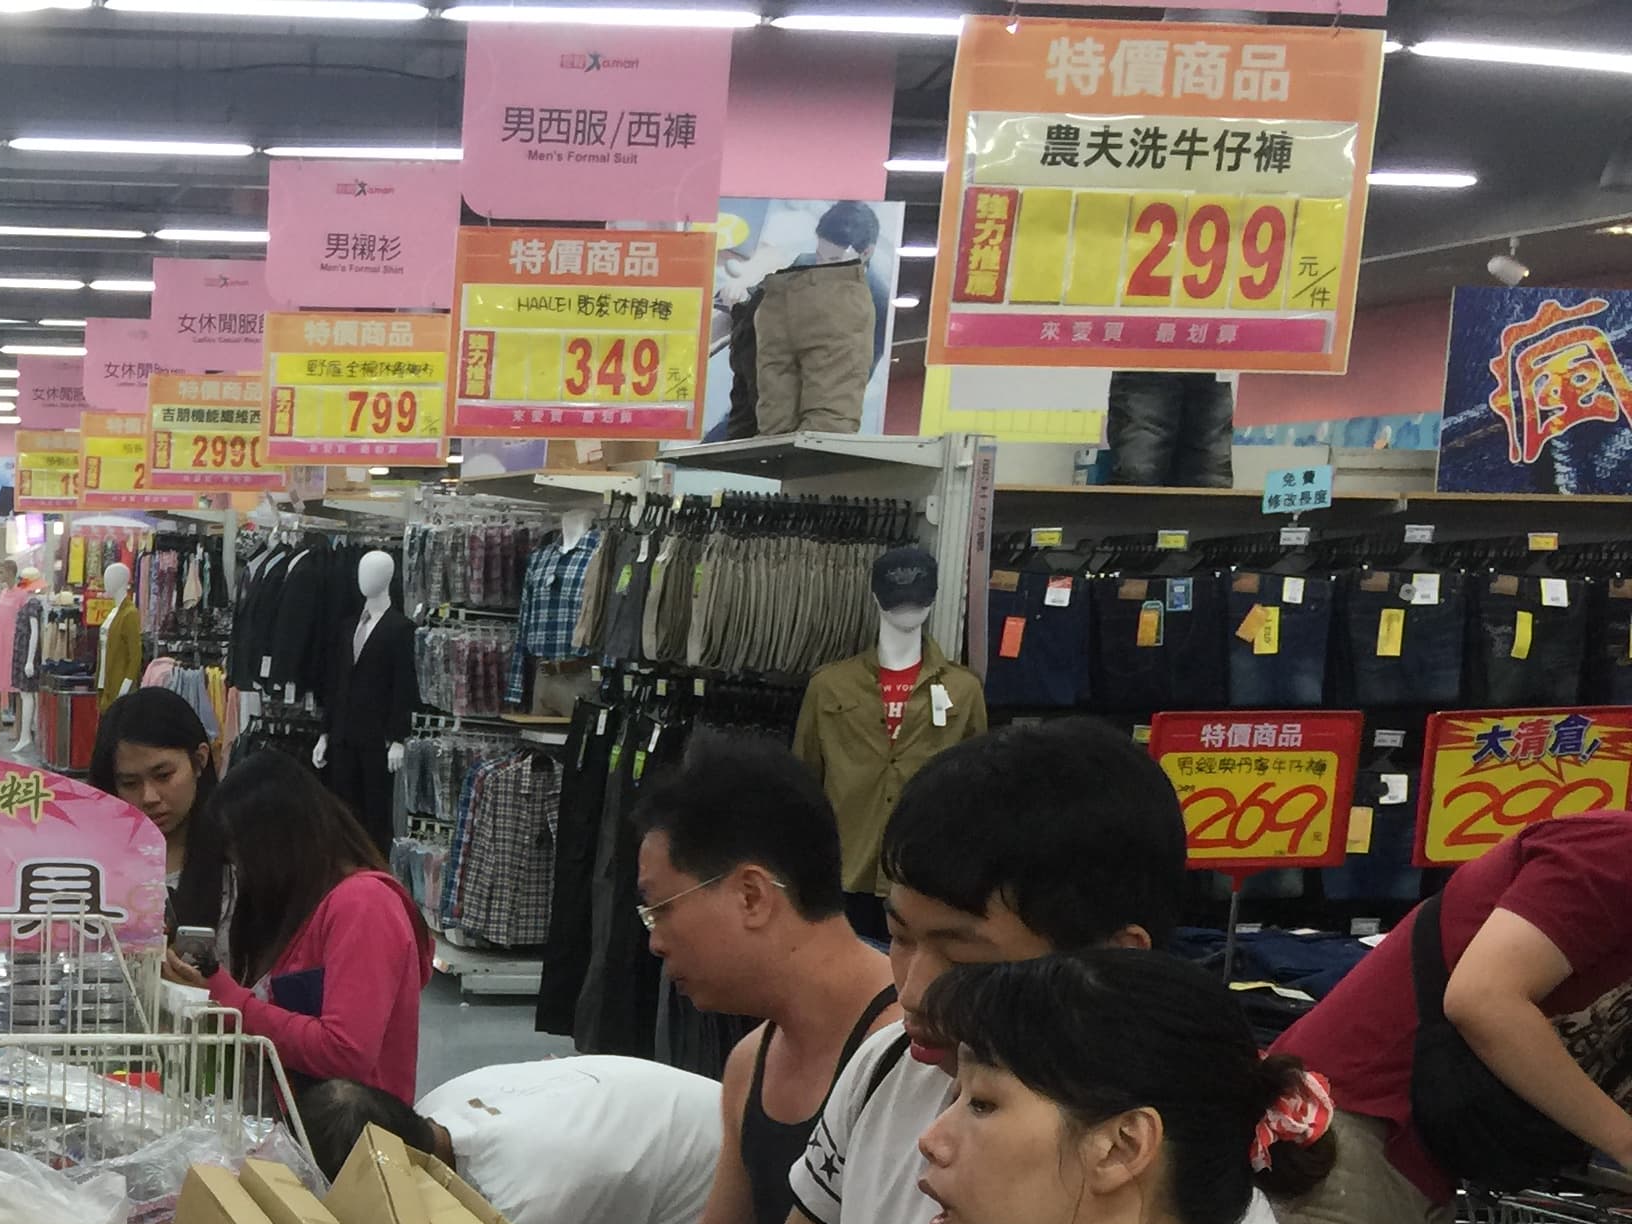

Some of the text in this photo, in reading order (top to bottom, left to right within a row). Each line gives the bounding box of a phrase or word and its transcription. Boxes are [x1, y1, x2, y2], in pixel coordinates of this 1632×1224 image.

[1045, 36, 1289, 102] 特價商品
[501, 106, 697, 149] 男西服/西褲
[1040, 123, 1294, 174] 農夫洗牛仔褲
[528, 149, 638, 164] Men's Formal Suit
[325, 233, 401, 261] 男襯衫
[509, 238, 659, 277] 特價商品
[1125, 201, 1287, 301] 299
[304, 320, 414, 347] 特價商品
[1040, 321, 1239, 344] 來愛買 最划算
[565, 337, 660, 396] 349
[348, 390, 417, 434] 799
[1200, 723, 1304, 748] 特價商品
[1181, 782, 1328, 854] 269
